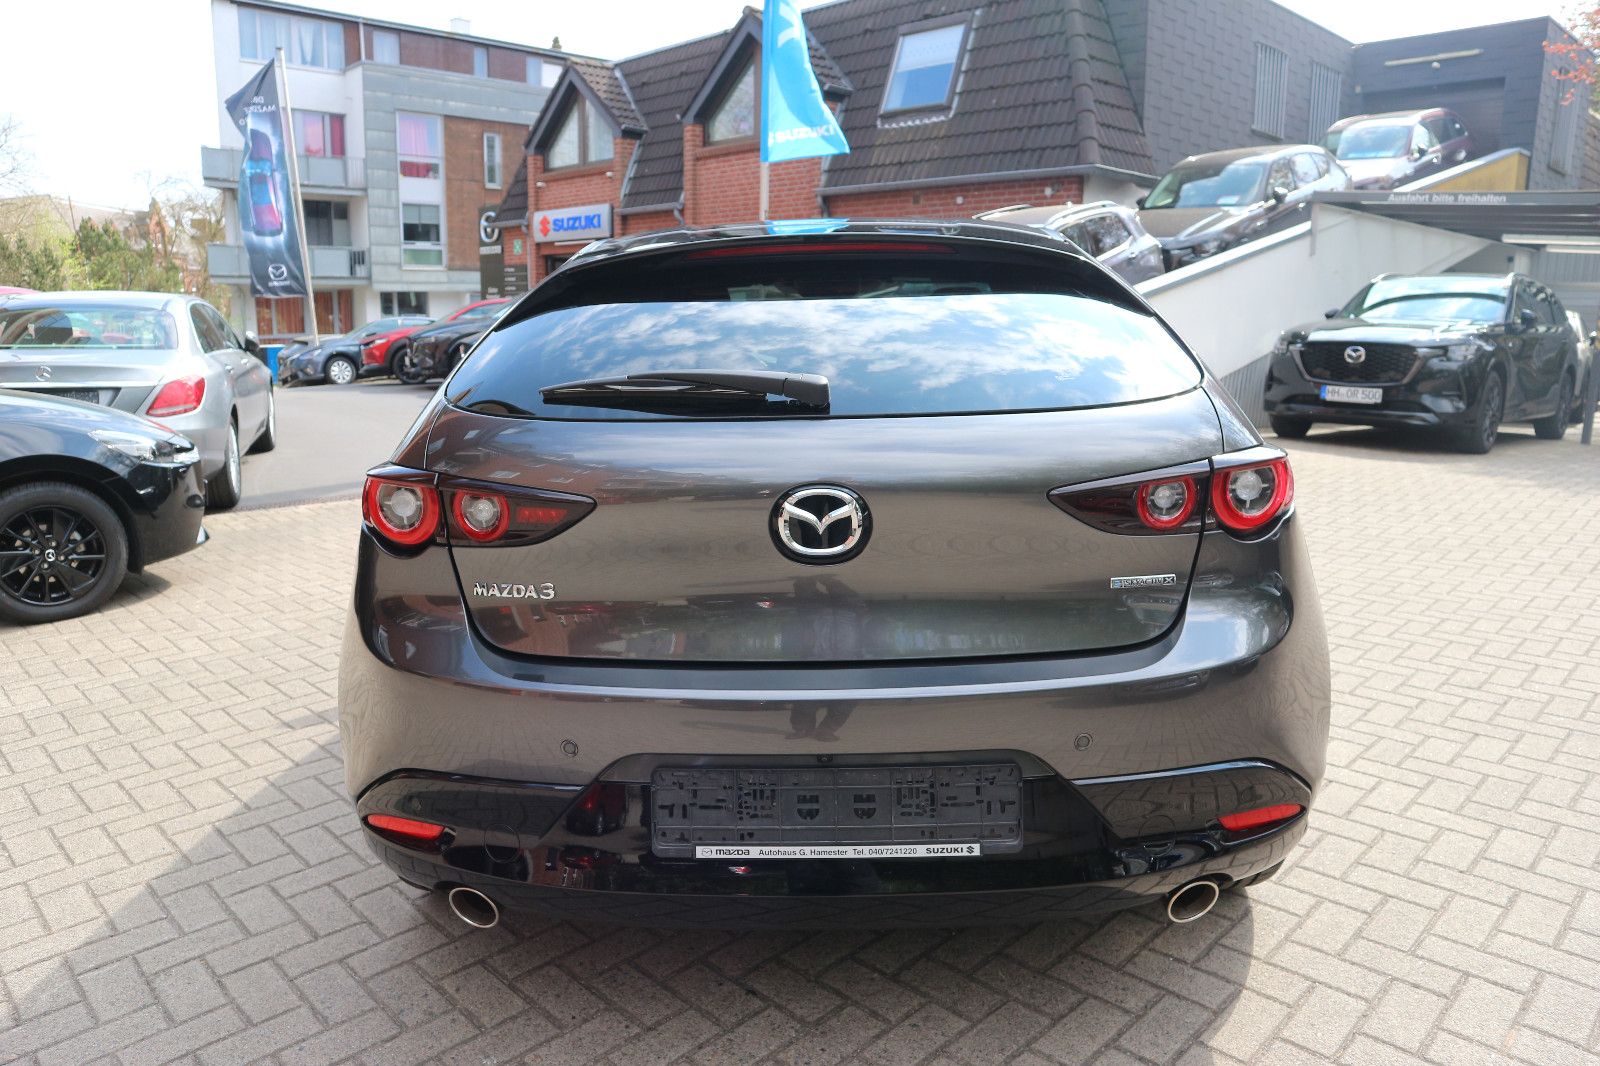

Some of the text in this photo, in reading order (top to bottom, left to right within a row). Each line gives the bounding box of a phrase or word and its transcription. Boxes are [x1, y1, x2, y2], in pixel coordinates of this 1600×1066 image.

[775, 124, 835, 143] SUZUKI
[1387, 193, 1507, 203] Ausfahrt bitte freihalten
[552, 213, 601, 232] SUZUKI
[758, 848, 797, 856] Autohaus
[798, 848, 808, 856] G.
[809, 847, 848, 856] Hamester
[852, 848, 866, 856] Tel.
[868, 847, 918, 856] 040/7241220
